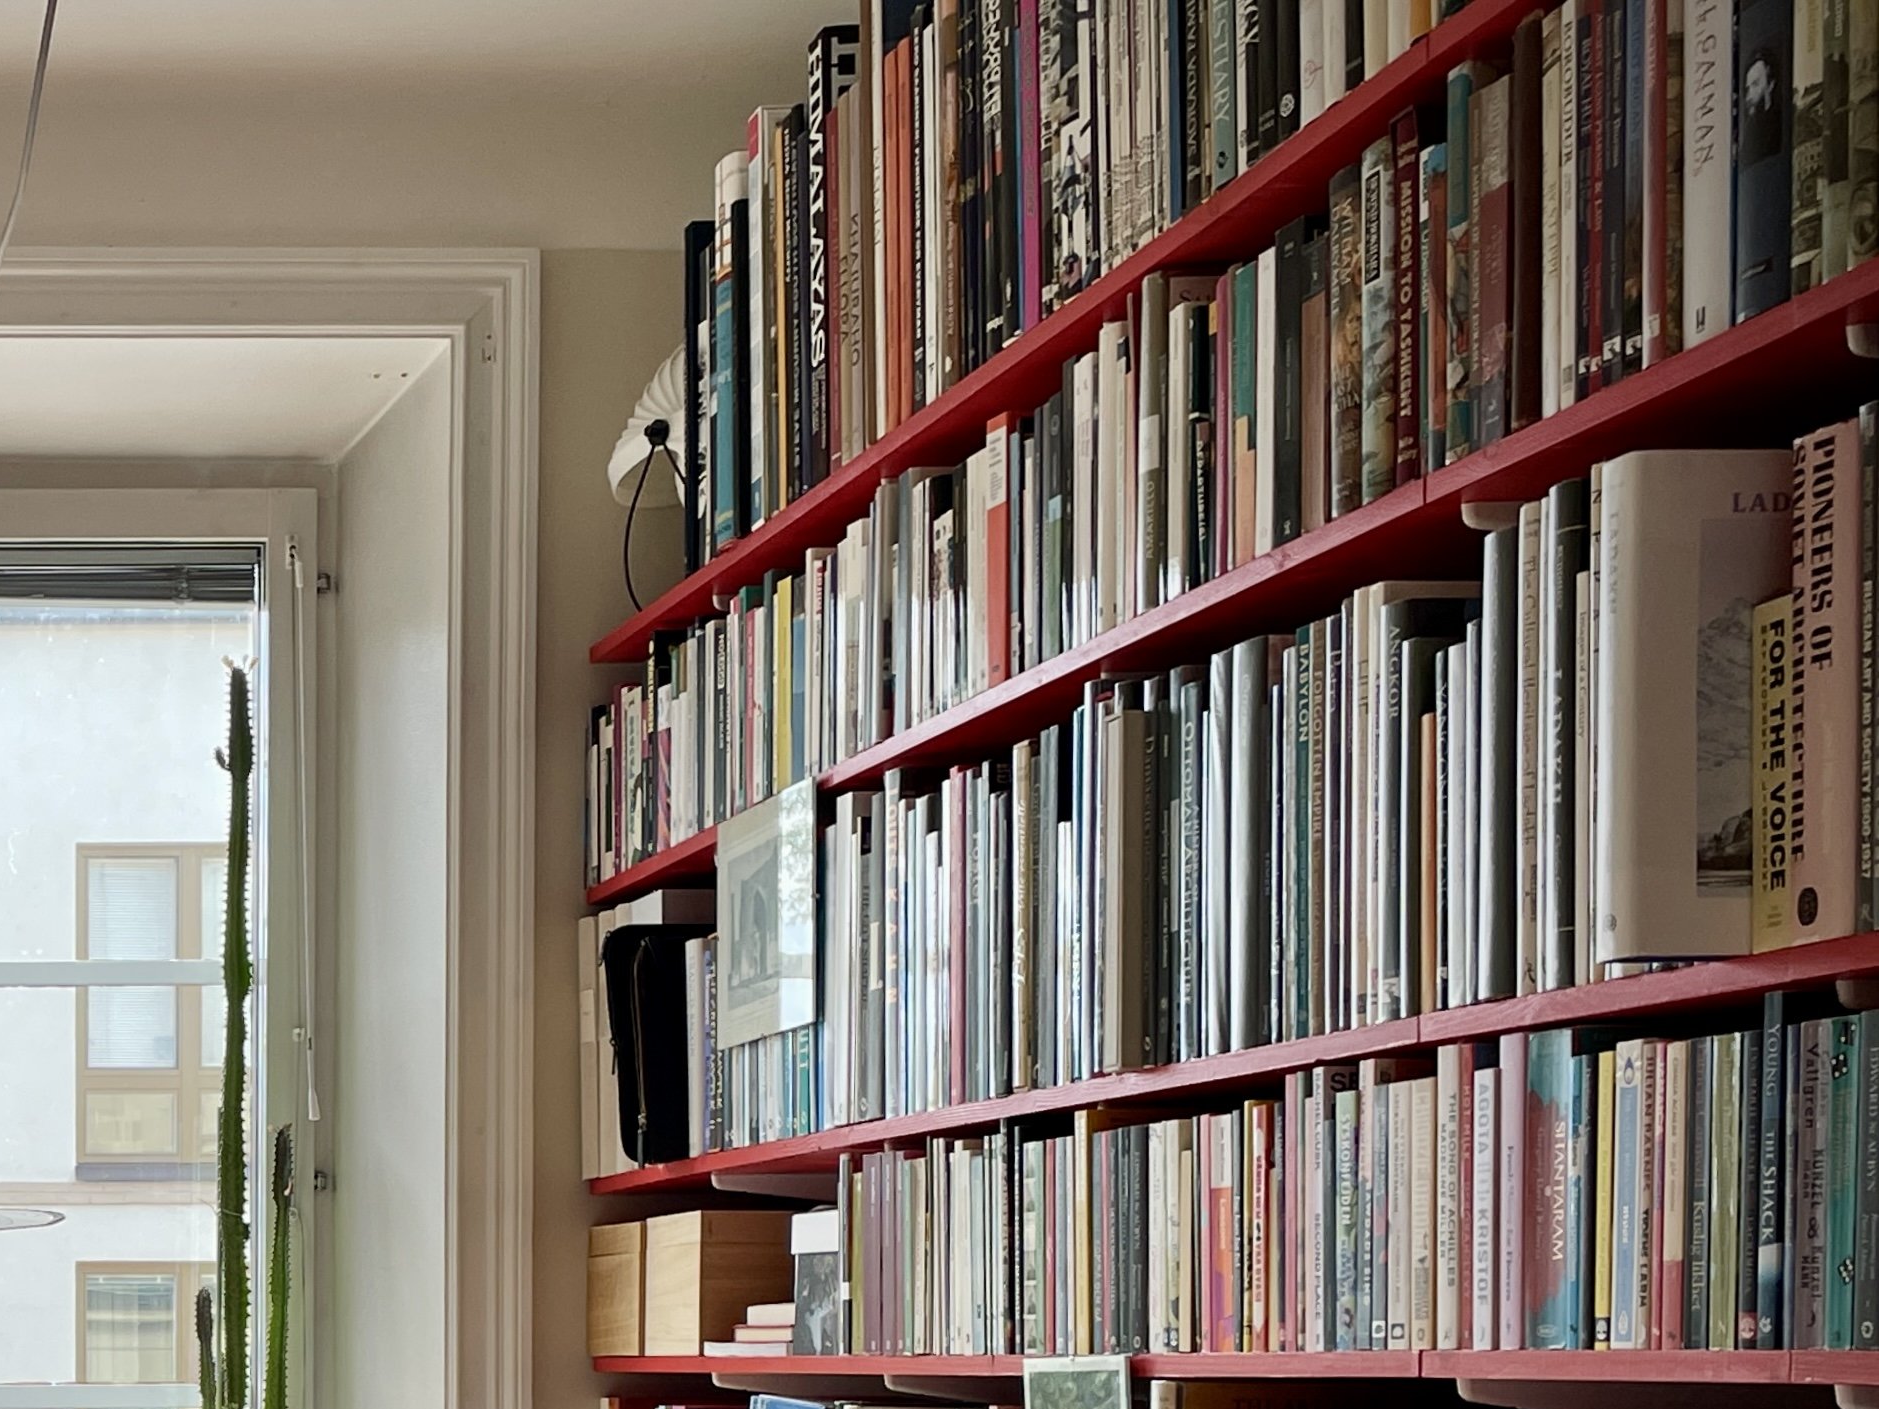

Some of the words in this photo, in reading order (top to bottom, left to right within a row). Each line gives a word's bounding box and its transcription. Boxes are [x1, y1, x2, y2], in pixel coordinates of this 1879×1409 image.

[1563, 22, 1573, 166] BOROBUDUR
[808, 40, 826, 368] HIMALAYAS
[1341, 197, 1353, 285] WILLIAM
[1401, 180, 1413, 268] MISSION
[1401, 273, 1413, 304] TO
[1400, 309, 1412, 417] TASHKENT
[1146, 482, 1154, 558] AMARILLO
[1811, 436, 1836, 613] PIONEERS
[1770, 619, 1786, 688] FOR
[1811, 625, 1836, 671] OF
[1863, 580, 1872, 654] RUSSIAN
[1299, 644, 1310, 742] BABYLON
[1389, 626, 1400, 720] ANGKOR
[1863, 657, 1872, 688] ART
[1863, 692, 1872, 725] AND
[1313, 671, 1323, 775] FORGOTTEN
[1770, 699, 1786, 771] THE
[1863, 727, 1872, 793] SOCIETY
[1183, 722, 1194, 835] OTTOMAN
[1313, 782, 1323, 840] EMPIRE
[1770, 782, 1786, 891] VOICE
[1863, 796, 1872, 879] 1900-1937
[1183, 847, 1194, 1006] ARCHITECTURE
[1766, 1023, 1782, 1096] YOUNG
[1804, 1043, 1820, 1129] Vallgren
[1478, 1084, 1491, 1154] AGOTA
[1765, 1130, 1776, 1160] THE
[1449, 1182, 1456, 1201] OF
[1552, 1121, 1566, 1260] SHANTARAM
[1691, 1201, 1706, 1254] Kuslig
[1763, 1161, 1778, 1241] SHACK
[1448, 1209, 1456, 1287] ACHILLES
[1478, 1209, 1491, 1306] KRISTOF
[1691, 1260, 1706, 1311] likhet
